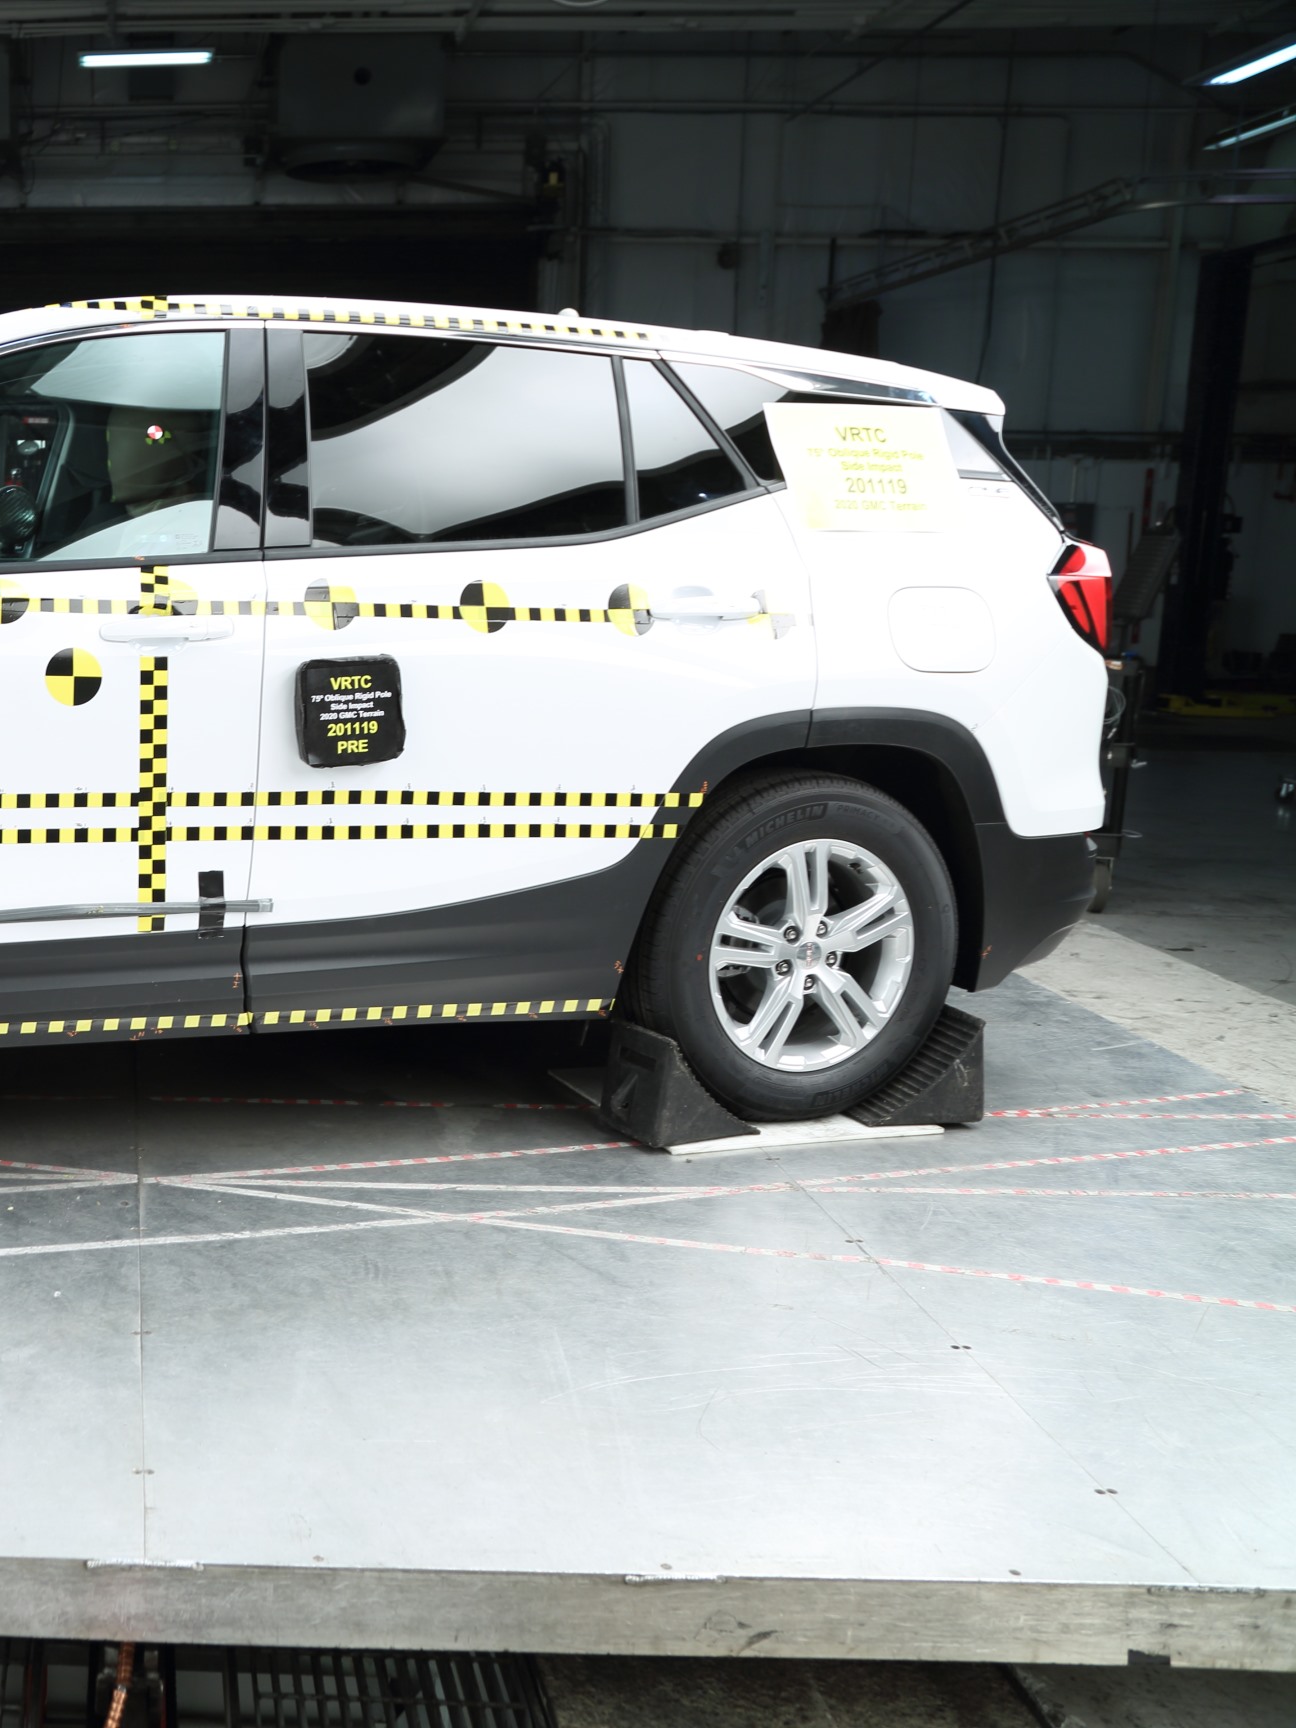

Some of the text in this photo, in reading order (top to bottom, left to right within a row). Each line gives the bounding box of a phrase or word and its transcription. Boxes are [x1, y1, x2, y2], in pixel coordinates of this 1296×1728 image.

[834, 426, 887, 443] VRTC
[840, 461, 903, 473] Side Impact
[845, 477, 908, 494] 201119
[330, 675, 372, 690] VRTC
[324, 693, 354, 703] Oblique
[354, 691, 374, 702] Rigid
[375, 690, 392, 699] Pole
[330, 701, 374, 711] Side Impact
[320, 709, 384, 721] 2020 GMC Terrain
[327, 720, 378, 737] 201119
[337, 739, 369, 754] PRE
[744, 804, 825, 849] MICHELIN
